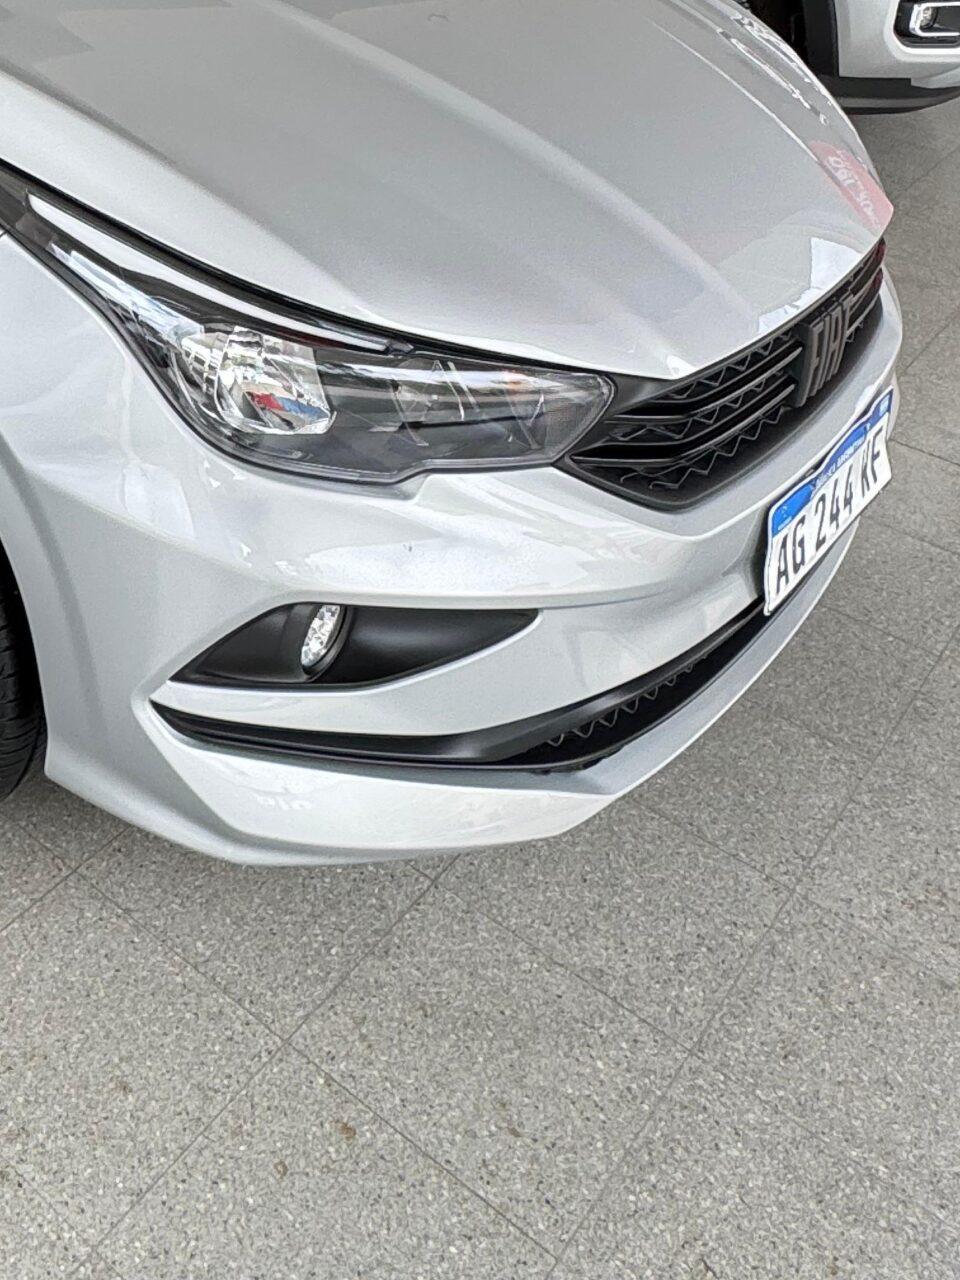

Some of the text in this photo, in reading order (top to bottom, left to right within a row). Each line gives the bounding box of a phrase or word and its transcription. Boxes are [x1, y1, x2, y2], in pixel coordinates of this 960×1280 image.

[804, 294, 856, 398] FIAT
[775, 514, 807, 595] AG
[814, 462, 855, 554] 244
[858, 425, 886, 499] KF
